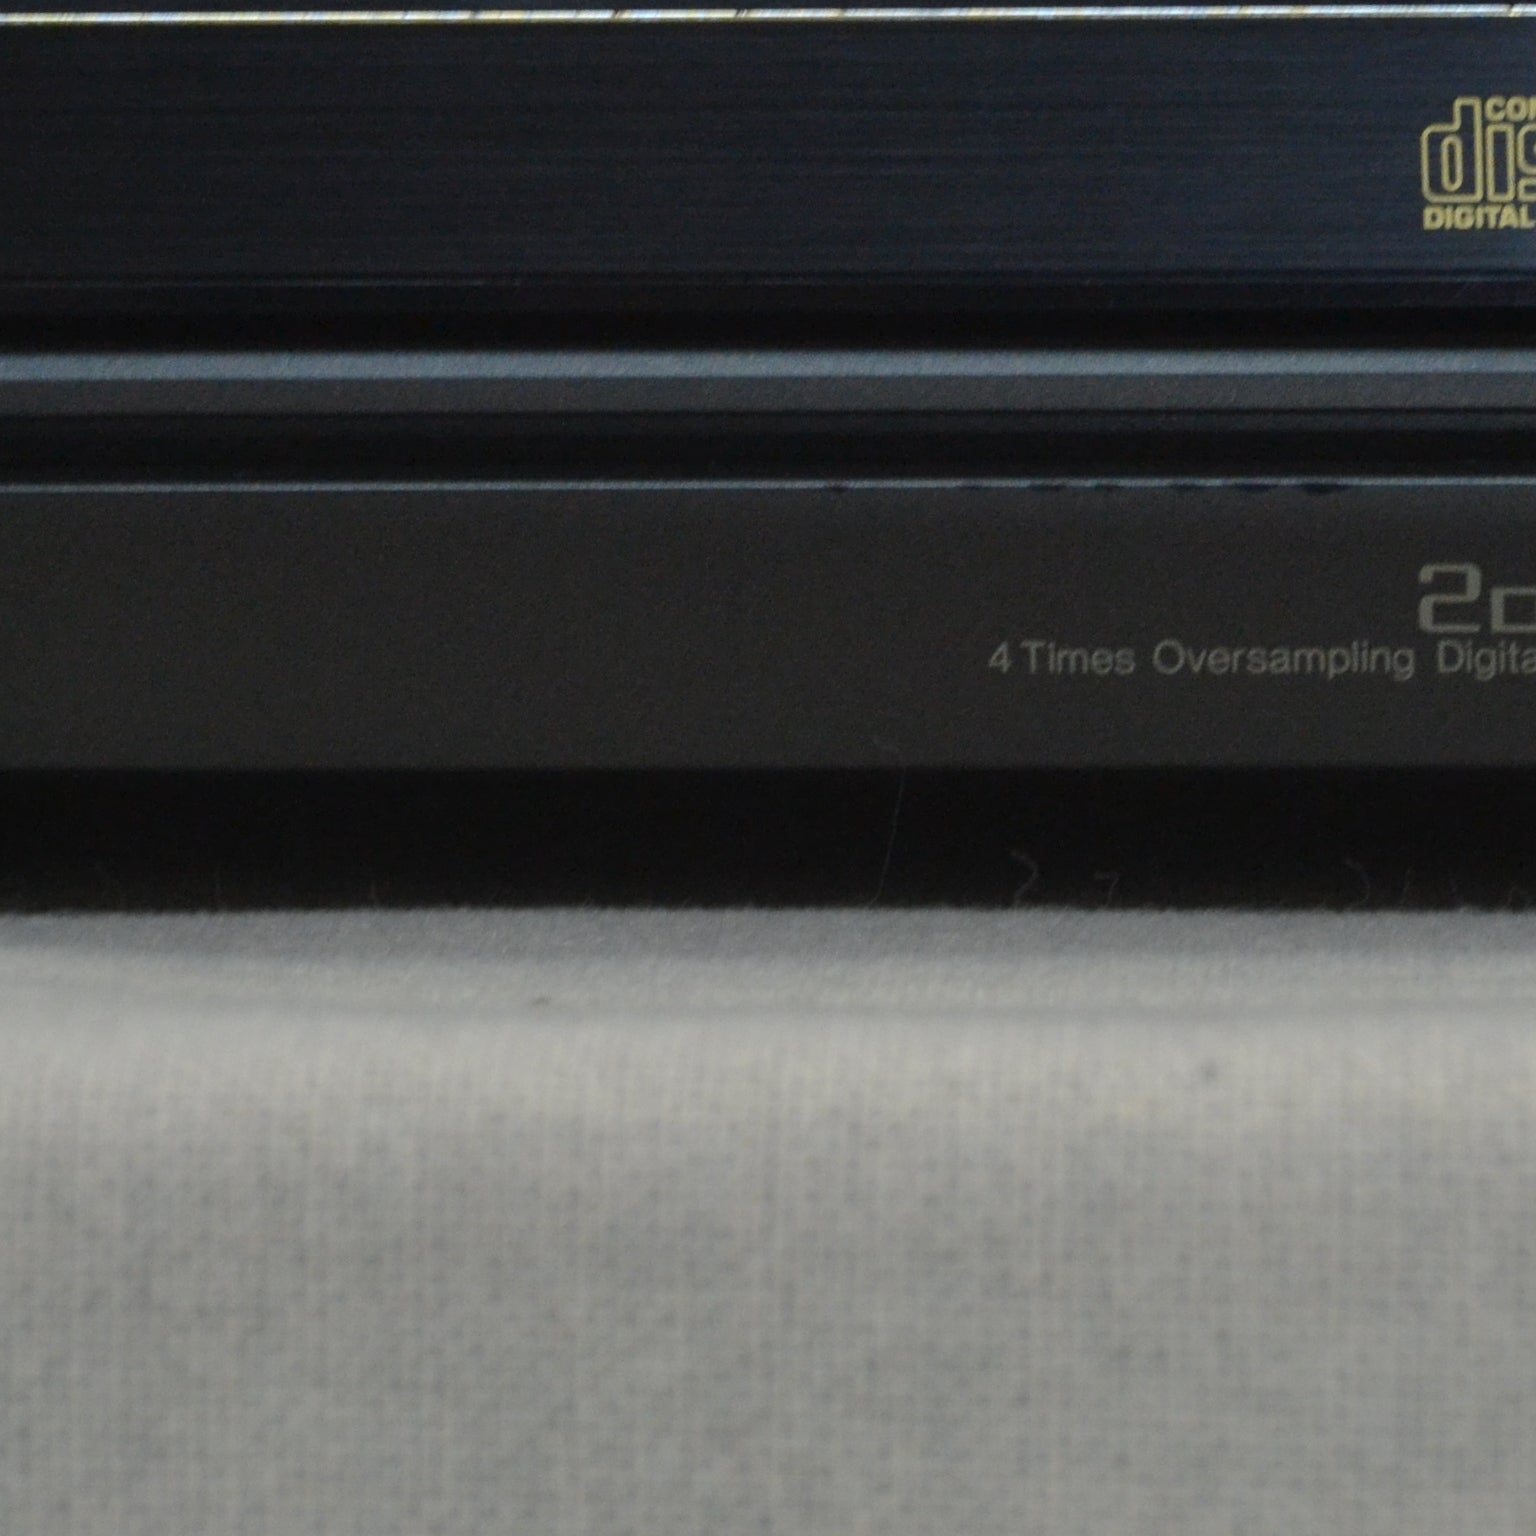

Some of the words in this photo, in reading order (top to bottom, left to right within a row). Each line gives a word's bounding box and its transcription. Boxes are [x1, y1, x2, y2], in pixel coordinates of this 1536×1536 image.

[1422, 205, 1536, 230] DIGITAL
[989, 642, 1012, 673] 4
[1020, 642, 1137, 675] Times
[1152, 640, 1416, 681] Oversampling
